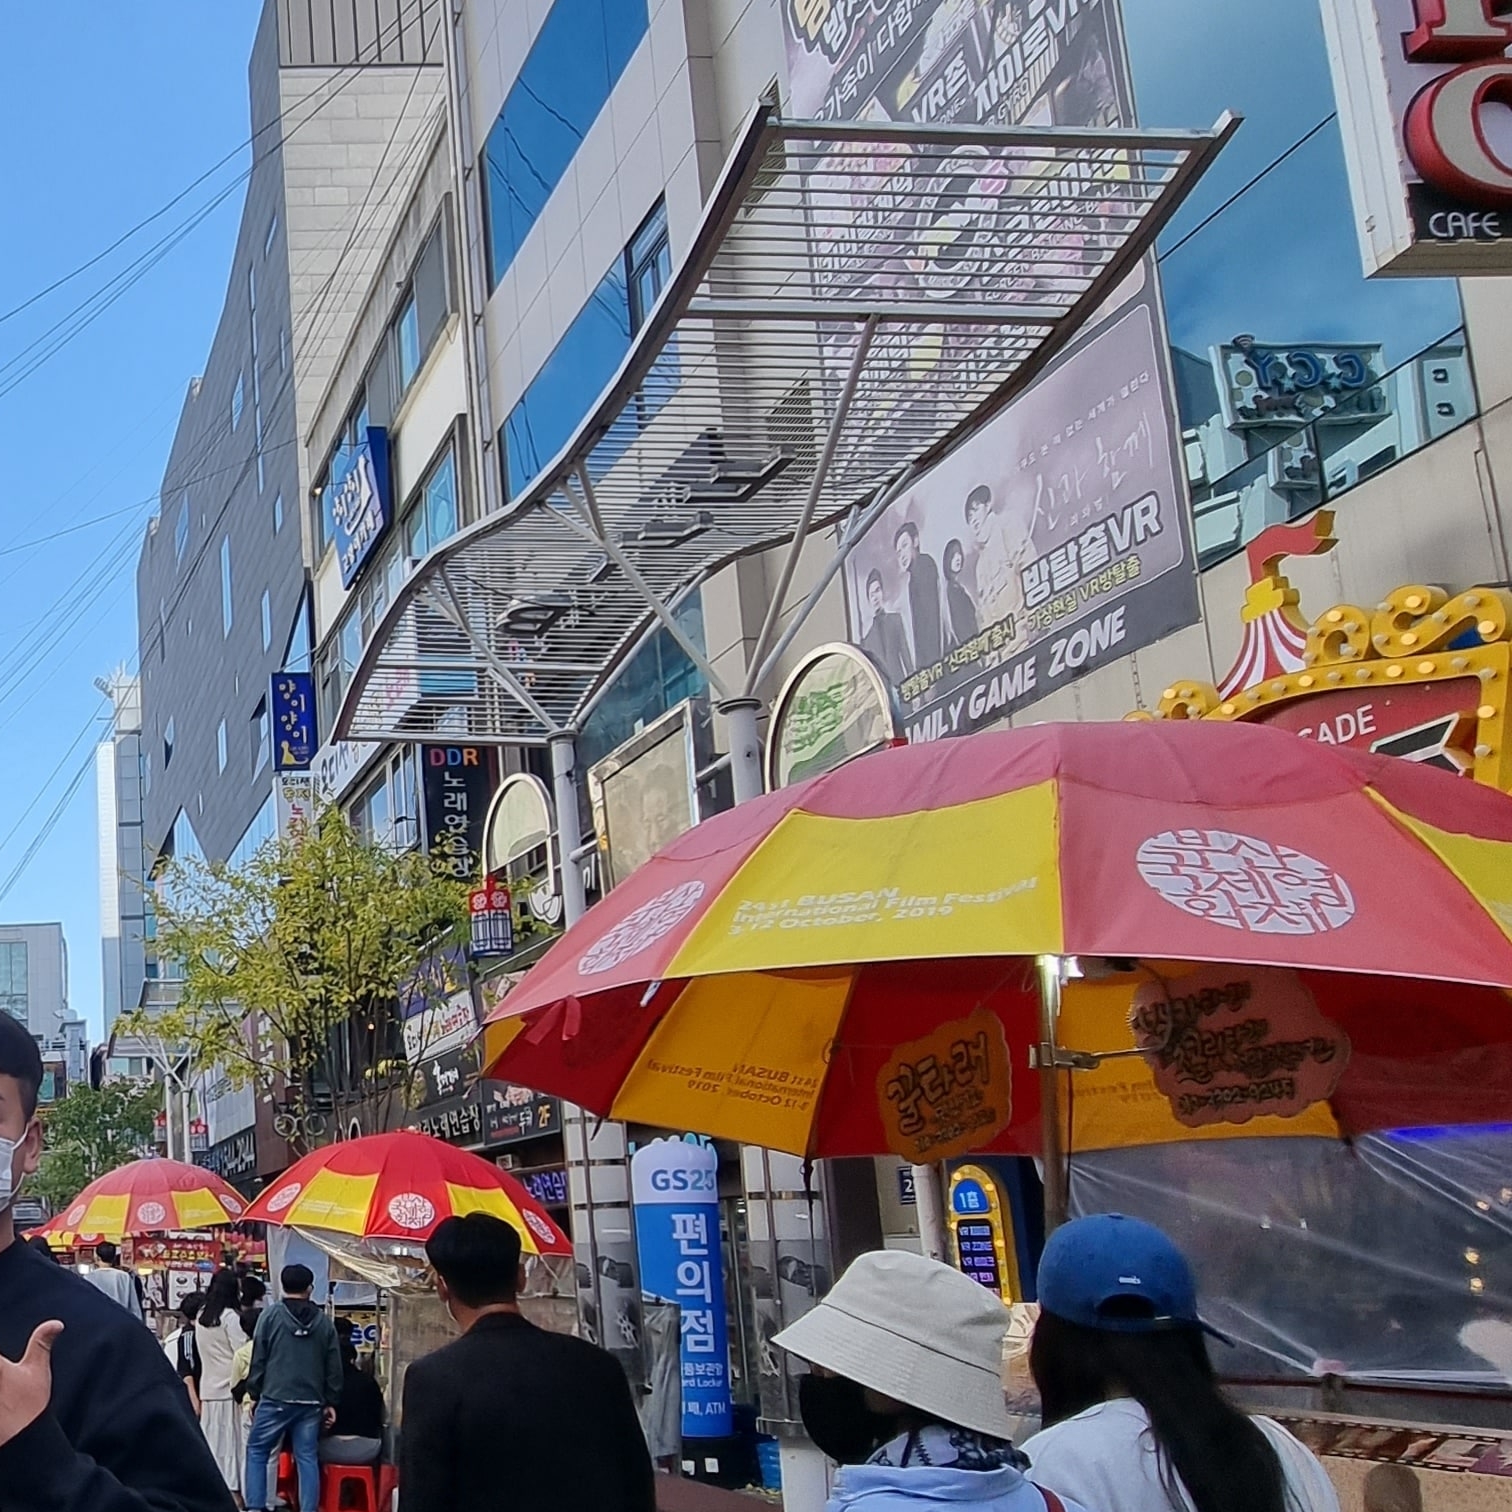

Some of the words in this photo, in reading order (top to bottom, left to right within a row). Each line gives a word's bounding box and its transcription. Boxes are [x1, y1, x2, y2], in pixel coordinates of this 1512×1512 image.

[1429, 212, 1502, 238] CAFE
[1021, 491, 1164, 609] 방탈출VR
[1079, 555, 1142, 602] VR방탈출
[968, 654, 1036, 723] GAME
[1047, 604, 1128, 681] ZONE
[430, 748, 479, 767] DDR
[732, 900, 879, 923] International
[886, 893, 938, 909] Film
[941, 875, 1037, 906] Festival
[795, 886, 901, 908] BUSAN
[891, 905, 954, 920] 2019
[888, 1031, 989, 1137] 꿀타래
[539, 1104, 552, 1129] 2F
[650, 1168, 716, 1193] GS25
[670, 1212, 716, 1354] 편의점
